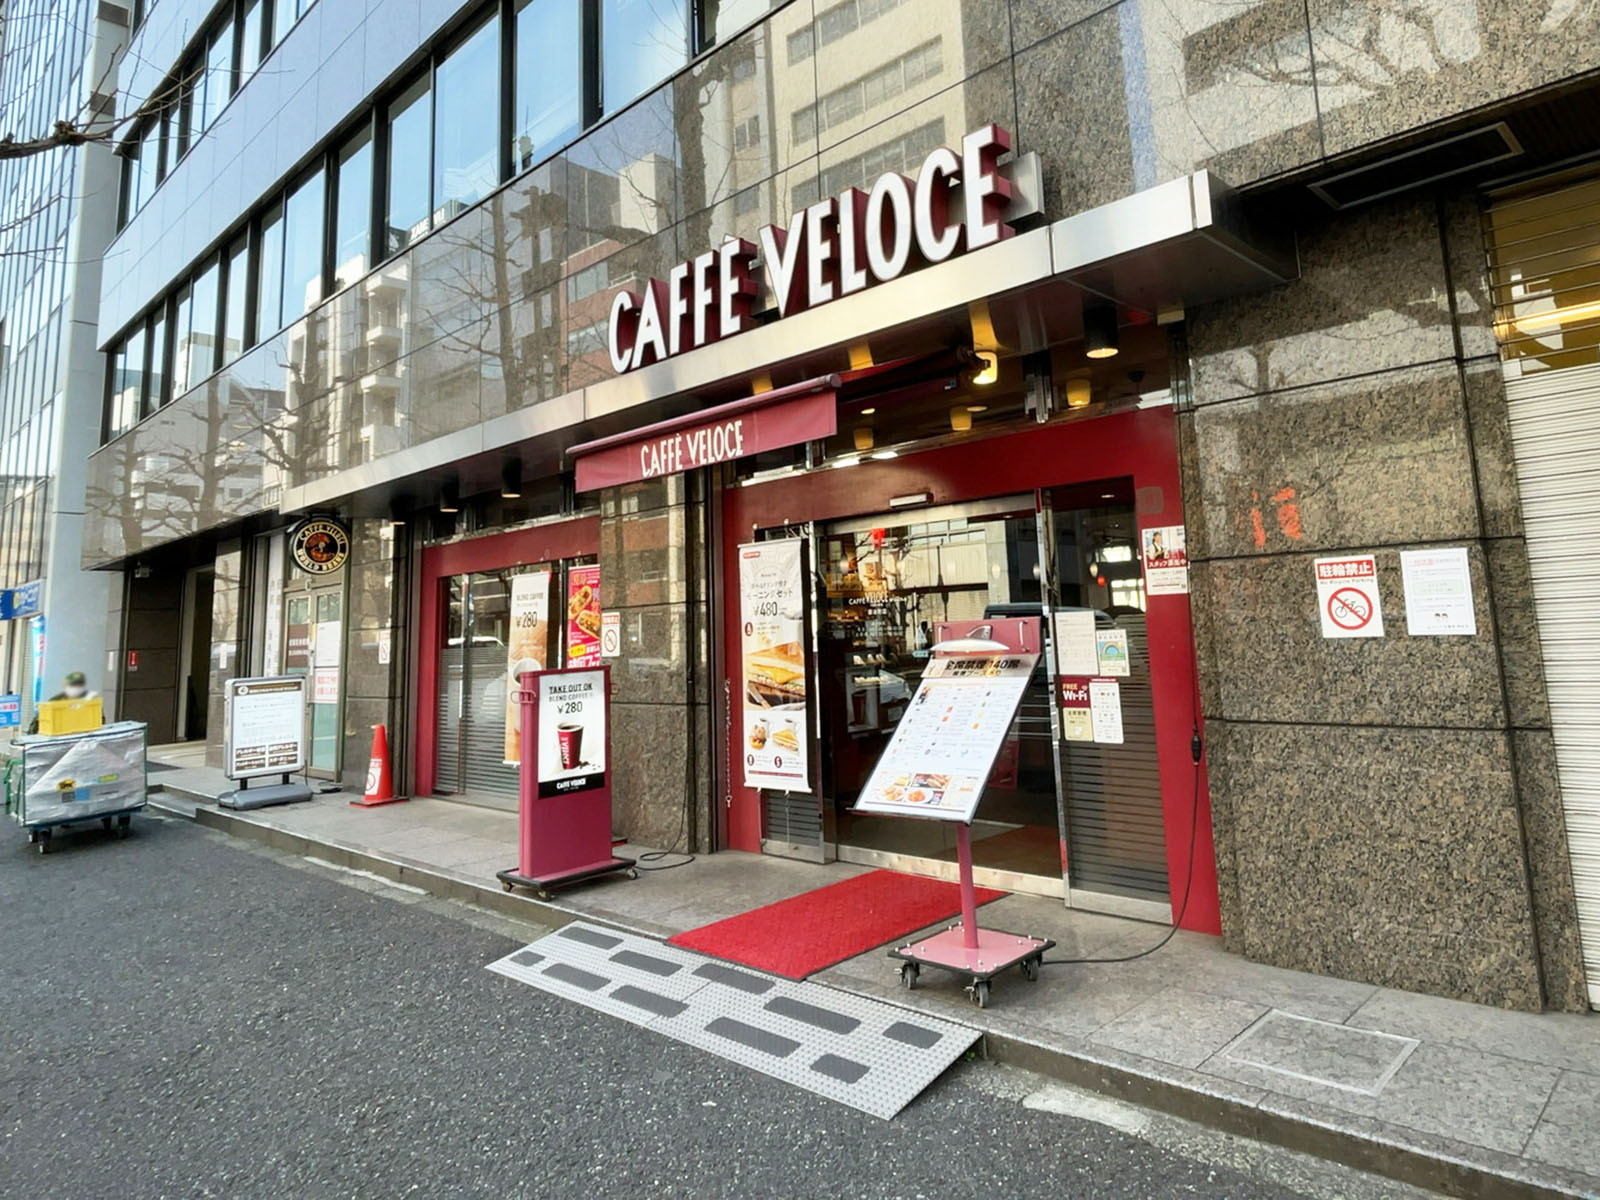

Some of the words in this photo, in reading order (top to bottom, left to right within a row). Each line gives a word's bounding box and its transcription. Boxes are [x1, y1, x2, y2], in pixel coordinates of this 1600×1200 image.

[759, 123, 1008, 318] VELOCE
[686, 420, 744, 465] VELOCE
[297, 548, 320, 571] WORLD
[322, 552, 345, 571] BEANS
[1319, 562, 1373, 578] 駐輪禁止
[549, 685, 567, 695] TAKE
[569, 683, 582, 693] OUT
[584, 682, 593, 691] OK
[1062, 689, 1088, 701] Wi-Fi
